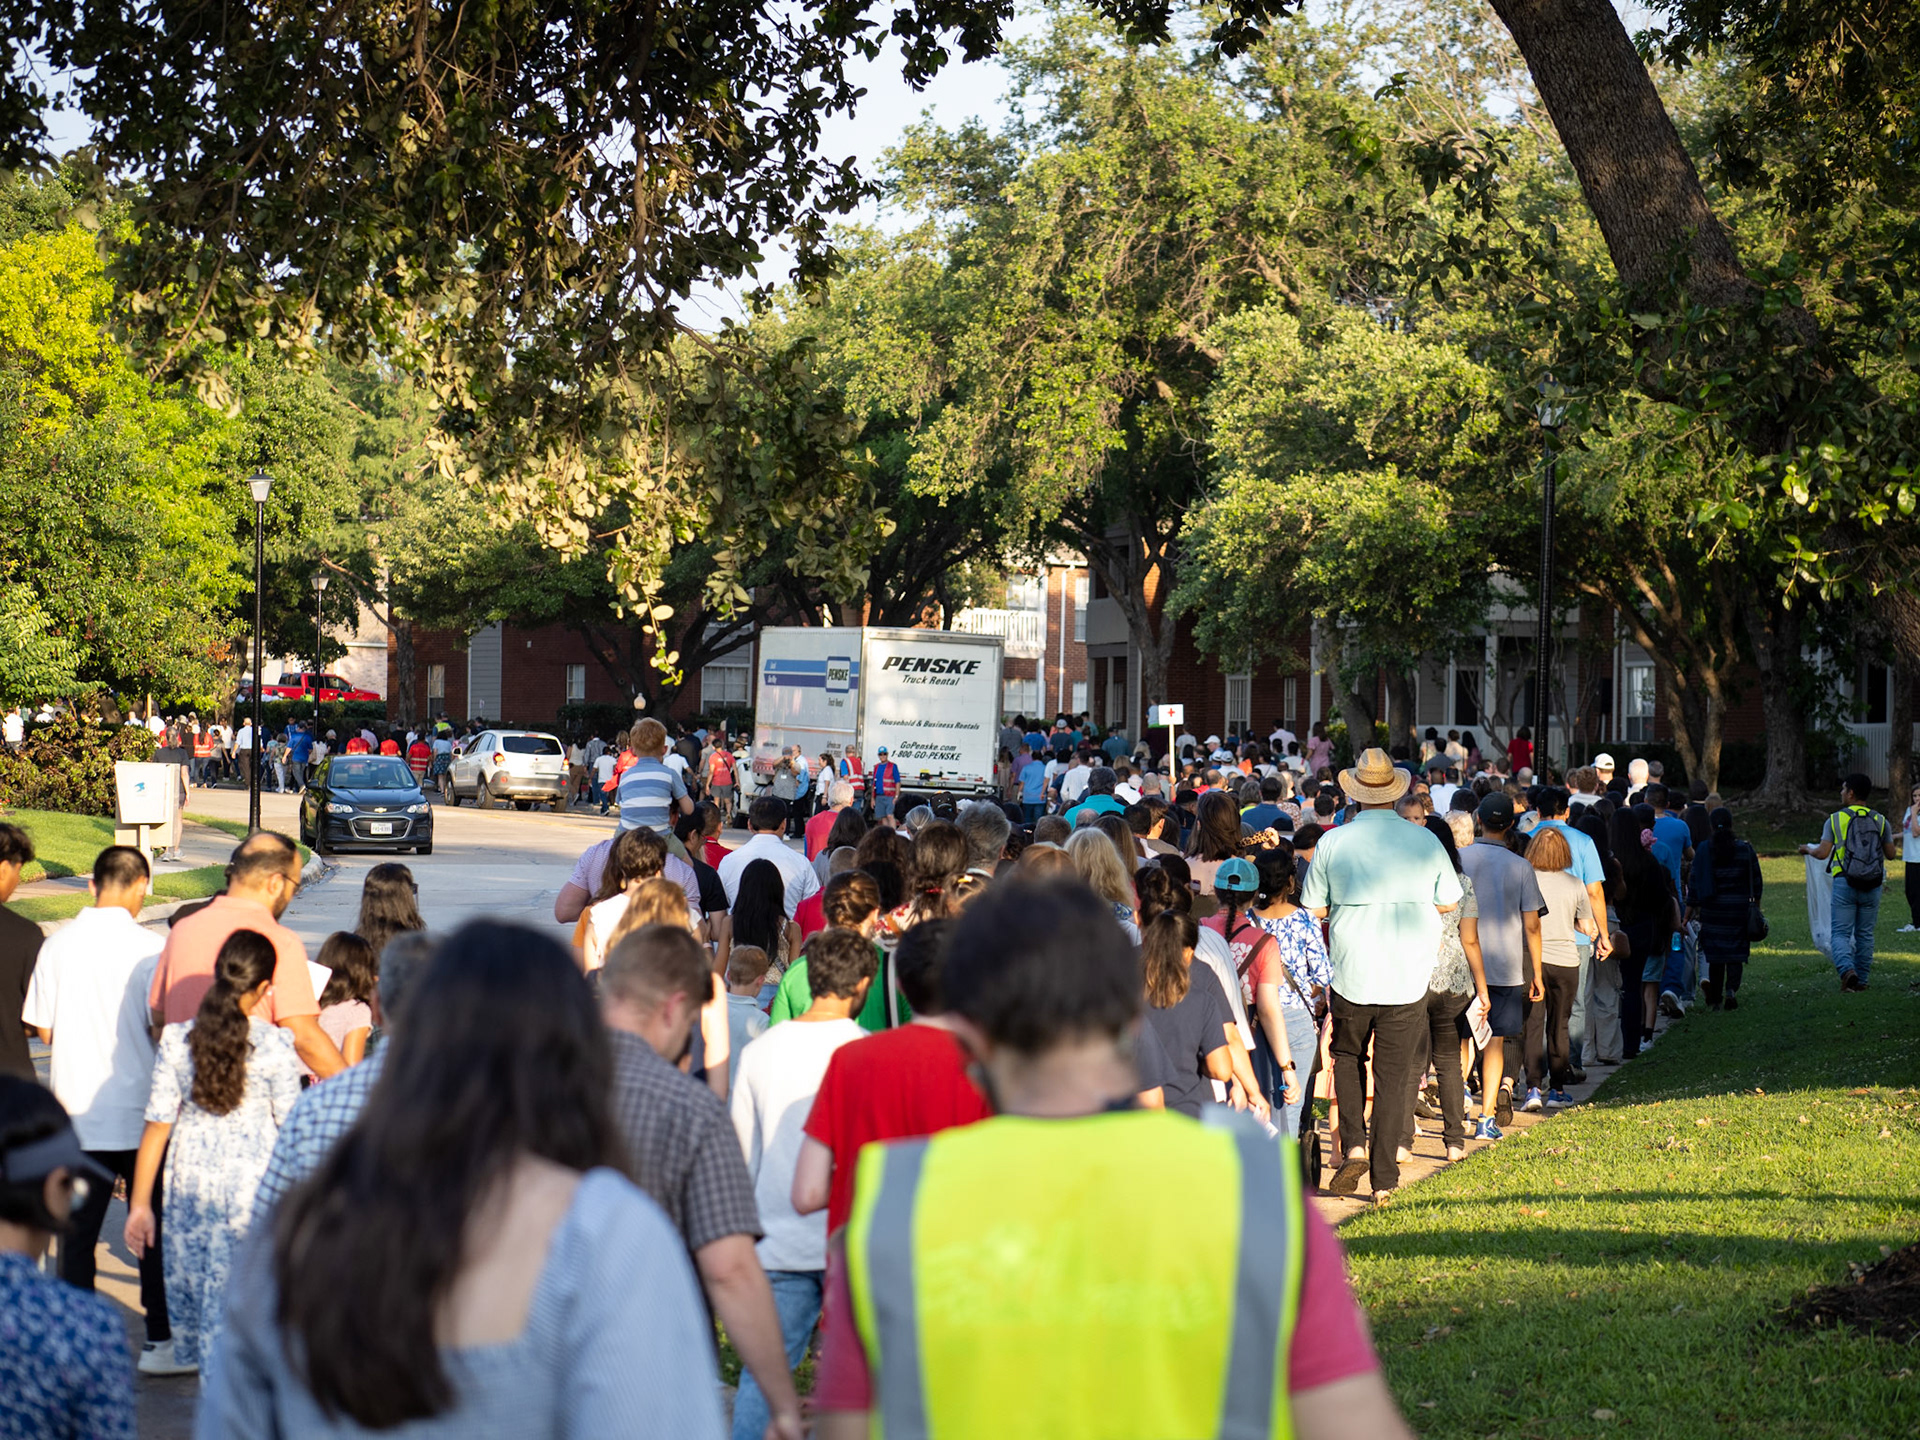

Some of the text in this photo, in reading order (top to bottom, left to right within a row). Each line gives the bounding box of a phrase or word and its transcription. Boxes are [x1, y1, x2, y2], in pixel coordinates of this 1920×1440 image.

[882, 656, 981, 675] PENSKE
[828, 668, 849, 681] PENSKE
[902, 675, 961, 686] Truck Rental
[879, 718, 980, 730] Household & Business Rentals
[900, 741, 957, 751] GoPenske.com
[891, 750, 962, 761] 1-800-GO-PENSKE
